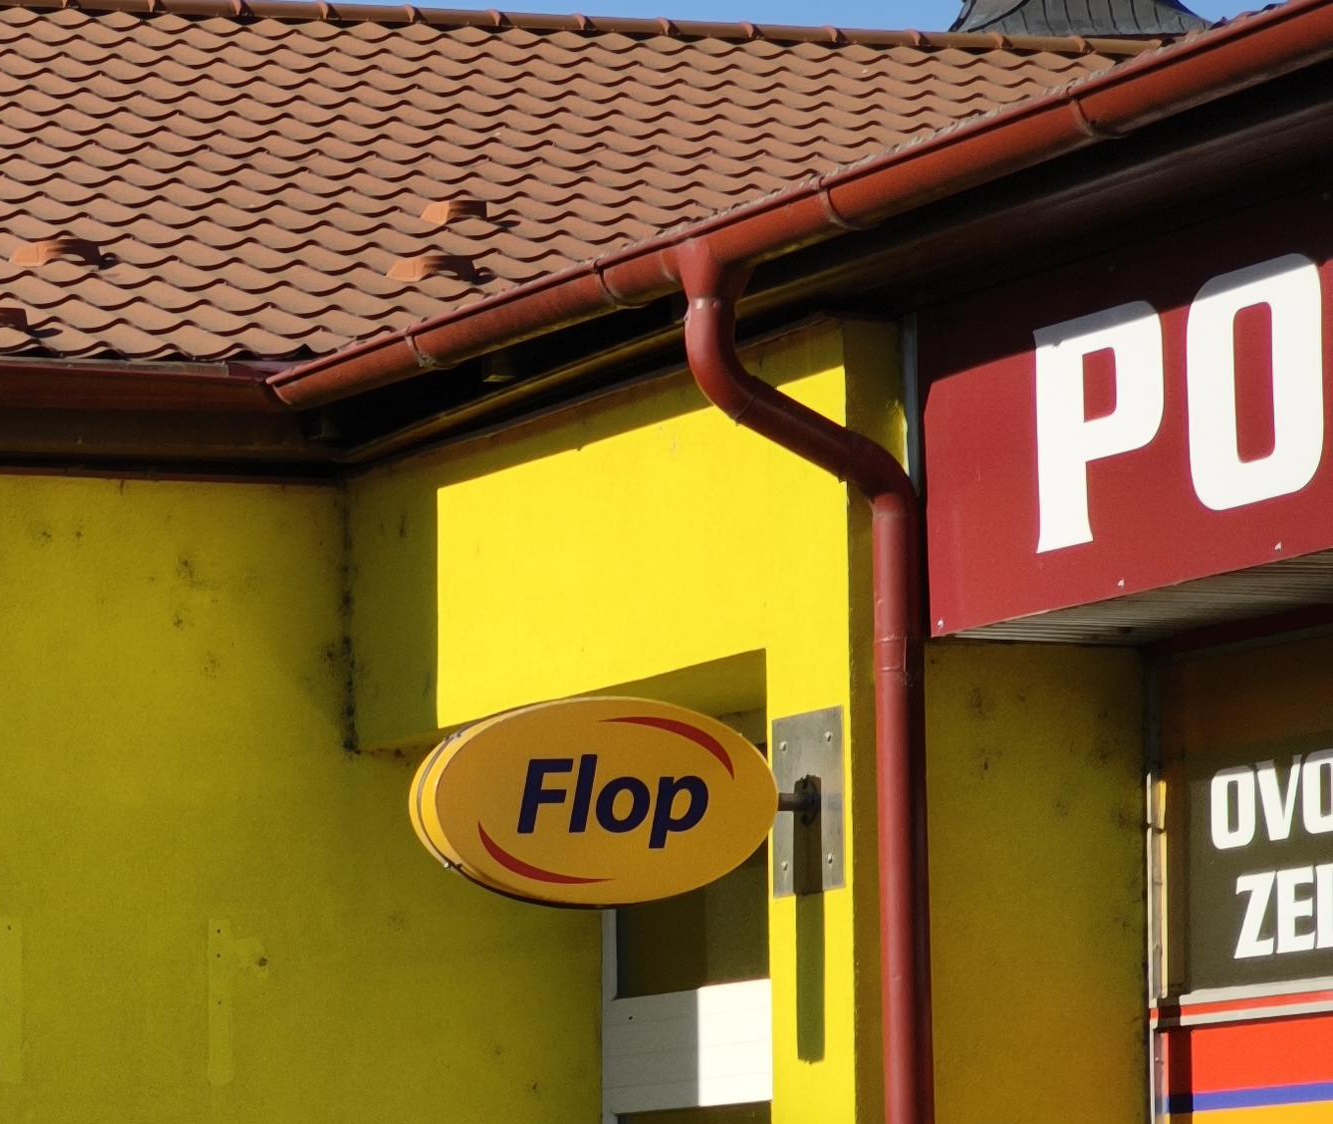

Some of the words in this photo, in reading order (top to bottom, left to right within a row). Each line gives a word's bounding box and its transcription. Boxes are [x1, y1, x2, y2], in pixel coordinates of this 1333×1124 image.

[1033, 253, 1325, 553] PO
[517, 754, 709, 849] Flop
[1211, 748, 1333, 850] OVO
